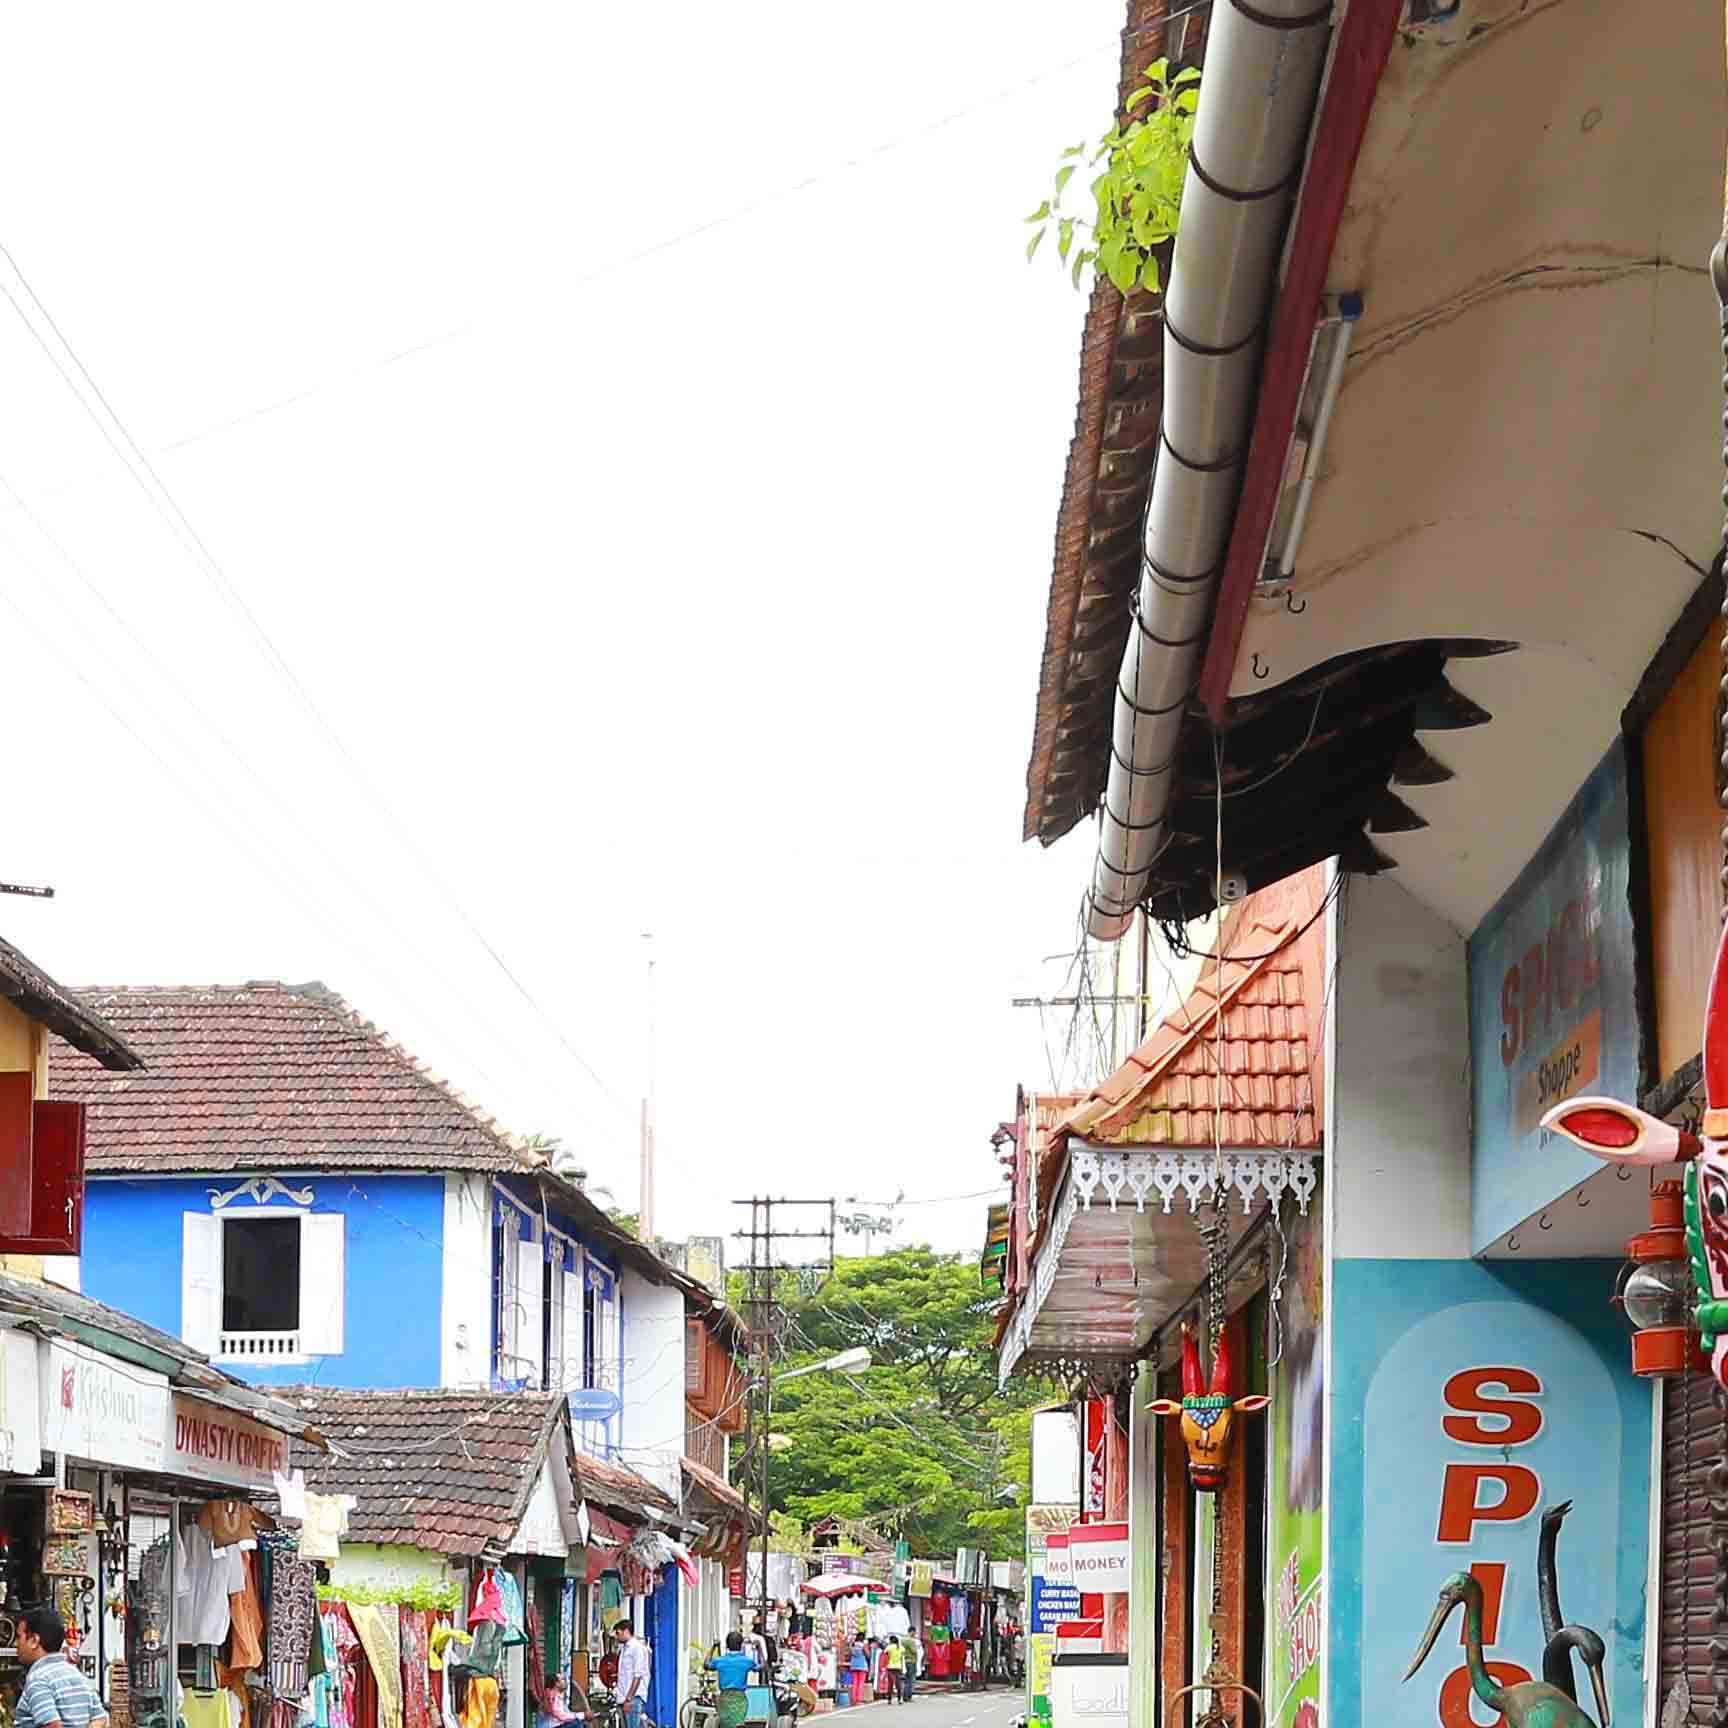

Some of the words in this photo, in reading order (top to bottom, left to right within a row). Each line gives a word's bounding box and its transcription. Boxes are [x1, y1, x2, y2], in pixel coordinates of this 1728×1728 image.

[175, 1414, 235, 1463] DYNASTY
[1048, 1560, 1069, 1574] MO
[1074, 1557, 1127, 1572] MONEY
